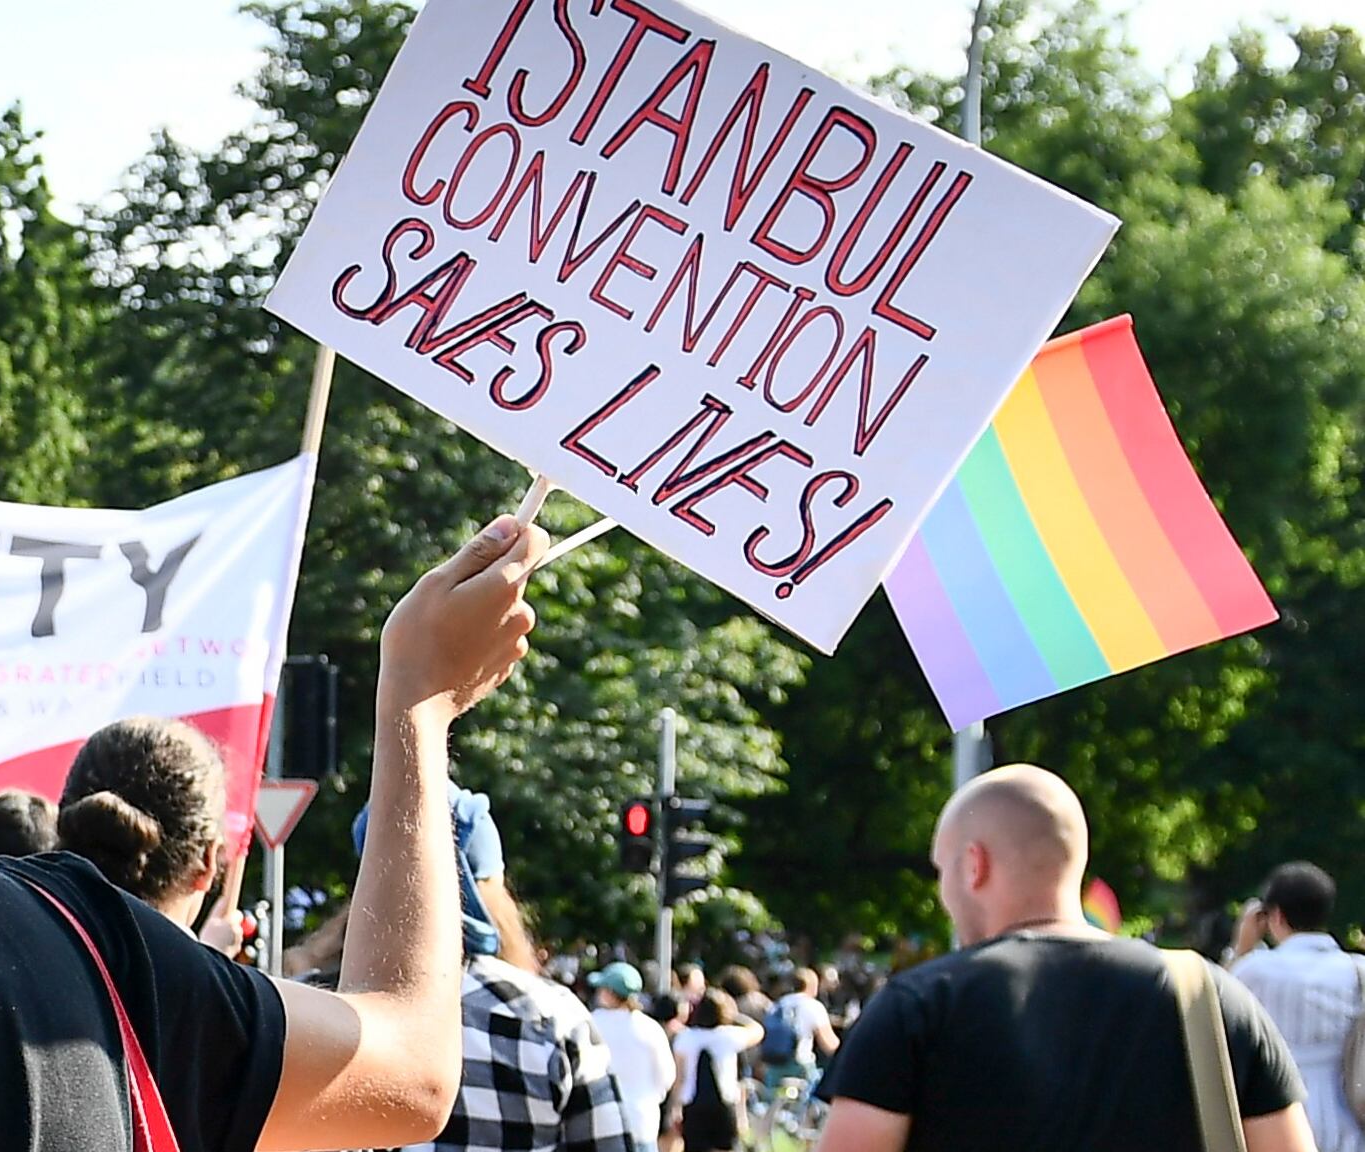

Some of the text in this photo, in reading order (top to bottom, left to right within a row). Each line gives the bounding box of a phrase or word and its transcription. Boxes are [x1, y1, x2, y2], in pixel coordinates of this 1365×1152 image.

[402, 101, 930, 456] CONVENTION
[463, 0, 974, 341] ISTANBUL
[332, 217, 893, 600] SAVES LIVES!
